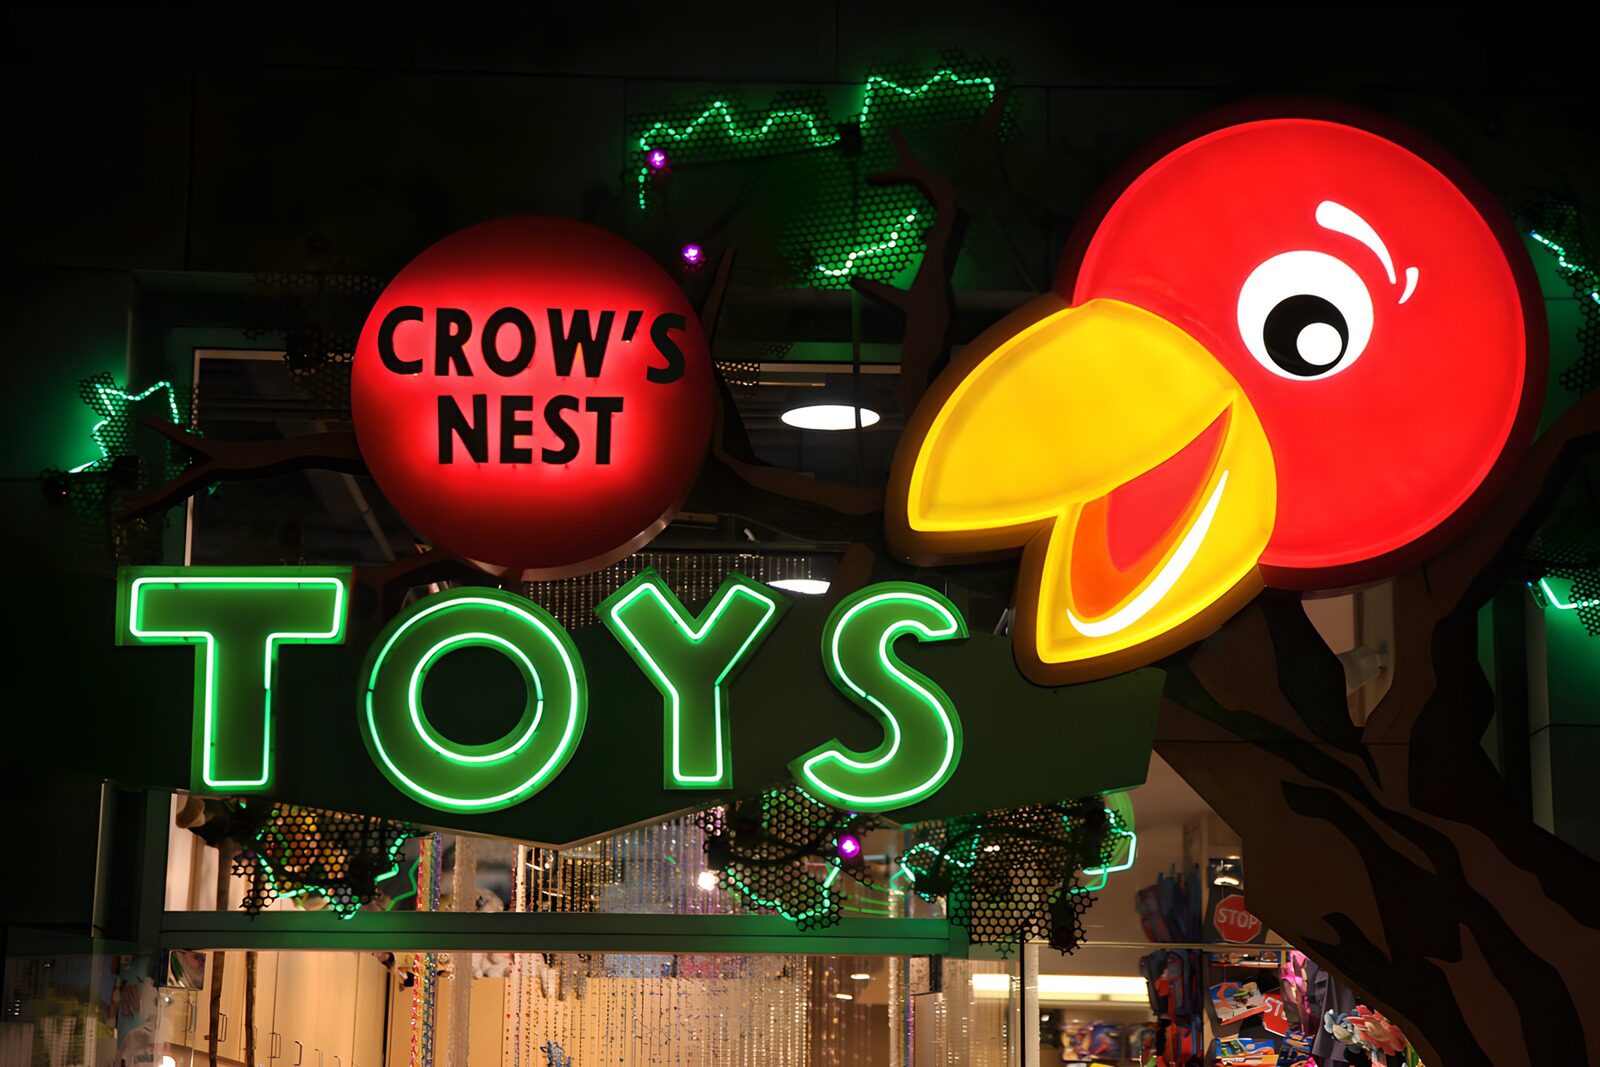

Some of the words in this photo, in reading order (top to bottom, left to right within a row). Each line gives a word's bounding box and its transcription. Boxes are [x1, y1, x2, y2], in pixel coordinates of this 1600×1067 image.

[378, 305, 687, 385] CROW'S
[437, 394, 624, 465] NEST
[115, 564, 970, 814] TOYS
[1217, 908, 1259, 929] STOP
